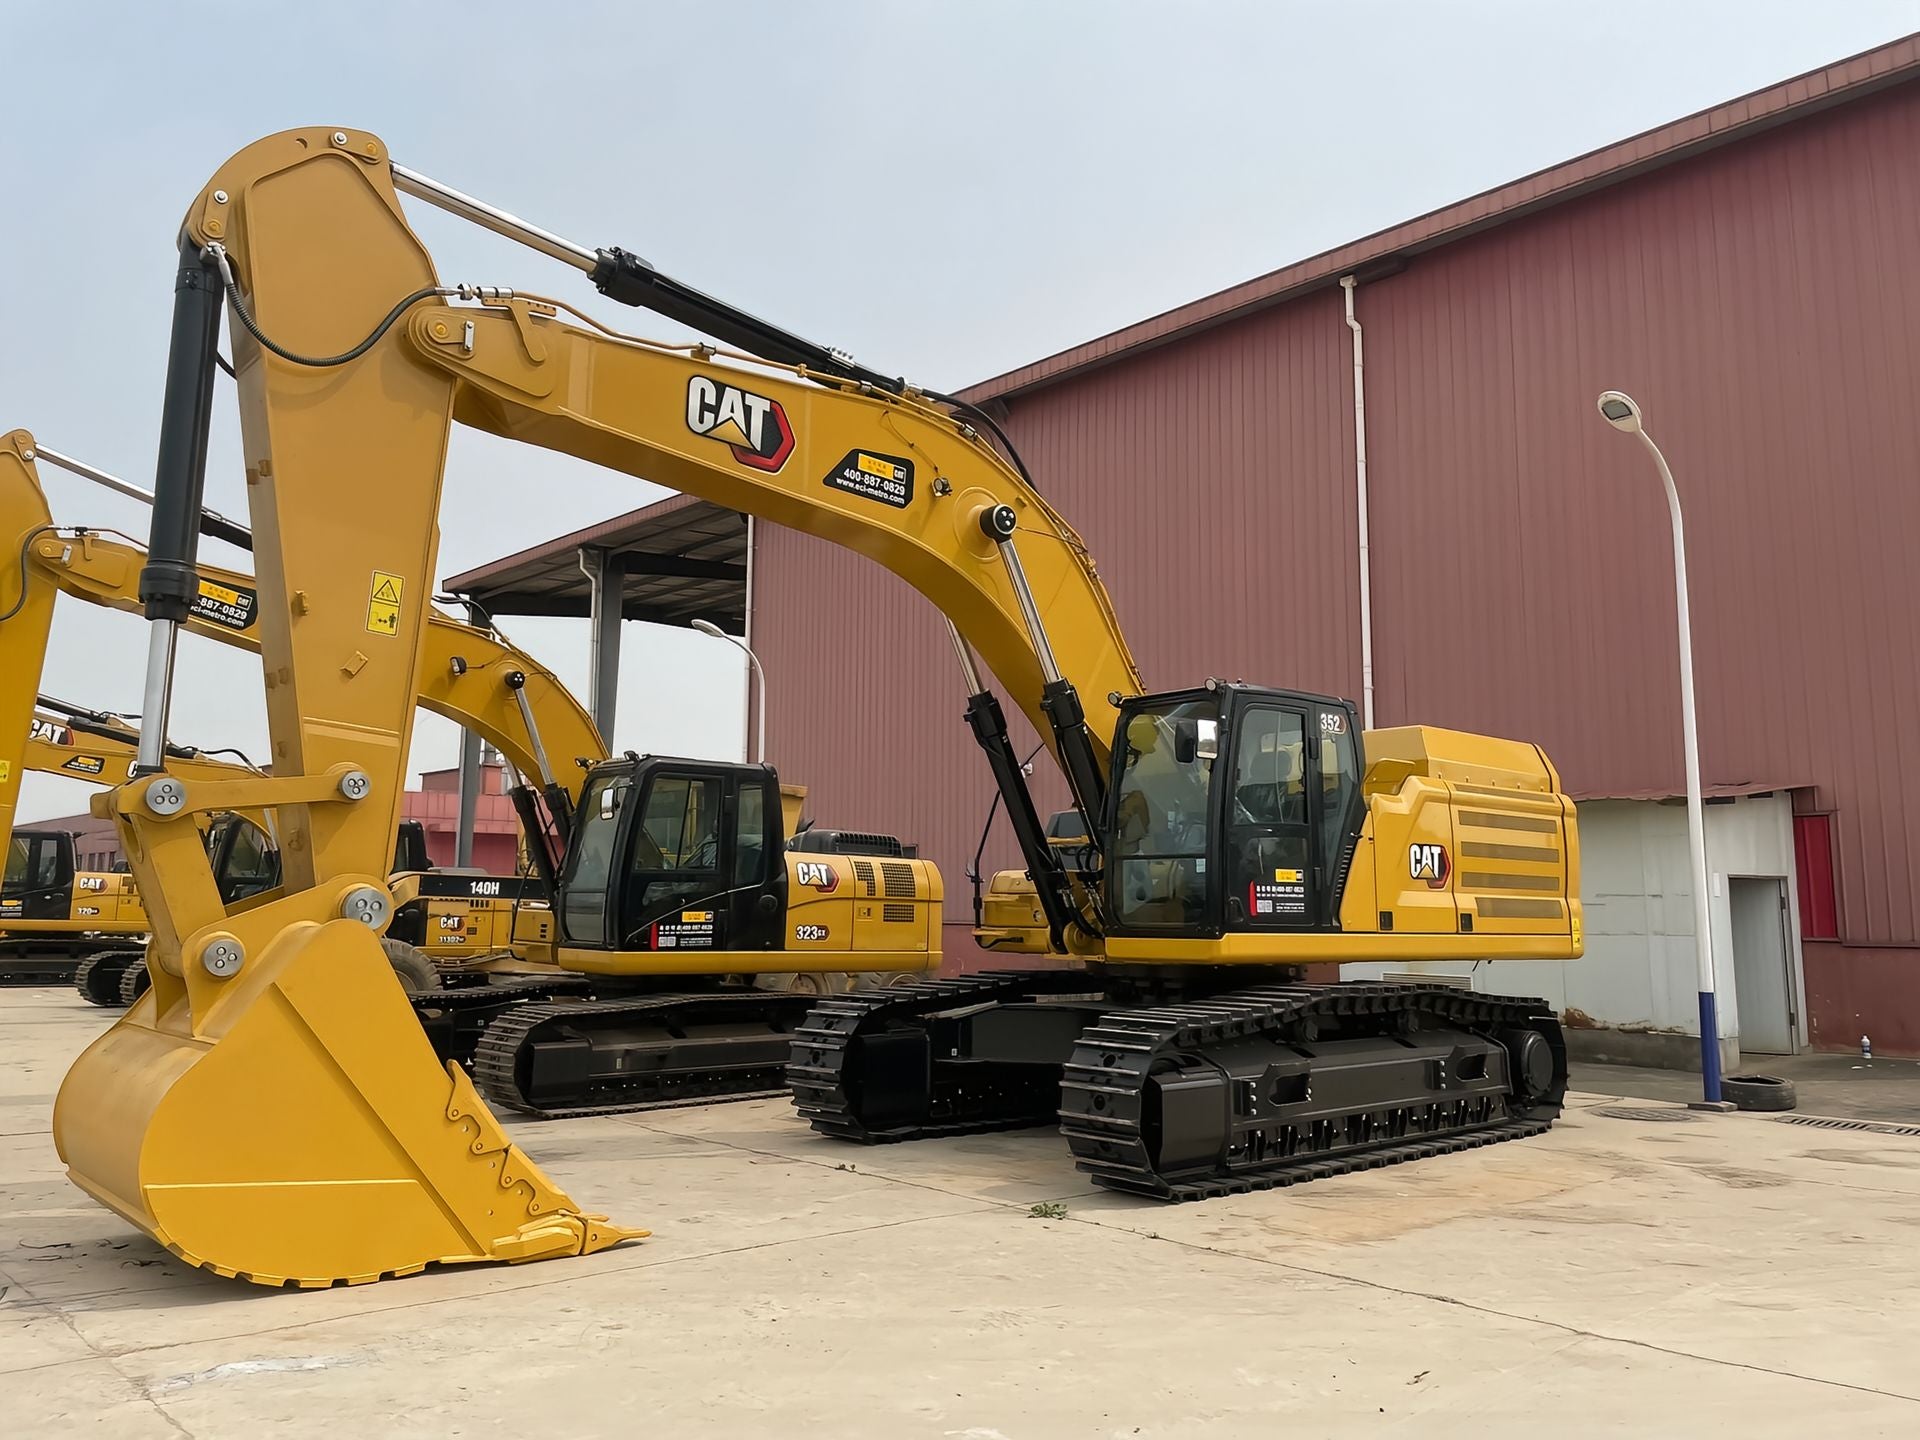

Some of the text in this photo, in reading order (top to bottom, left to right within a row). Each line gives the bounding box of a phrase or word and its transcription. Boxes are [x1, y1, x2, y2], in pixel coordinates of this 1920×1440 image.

[689, 376, 770, 452] CAT
[843, 468, 905, 496] 400-887-0829
[198, 597, 247, 620] -887-0829
[1320, 713, 1341, 732] 352
[1410, 844, 1441, 879] CAT
[80, 878, 103, 890] CAT
[797, 862, 828, 886] CAT
[470, 881, 500, 895] 140H
[440, 916, 460, 929] CAT
